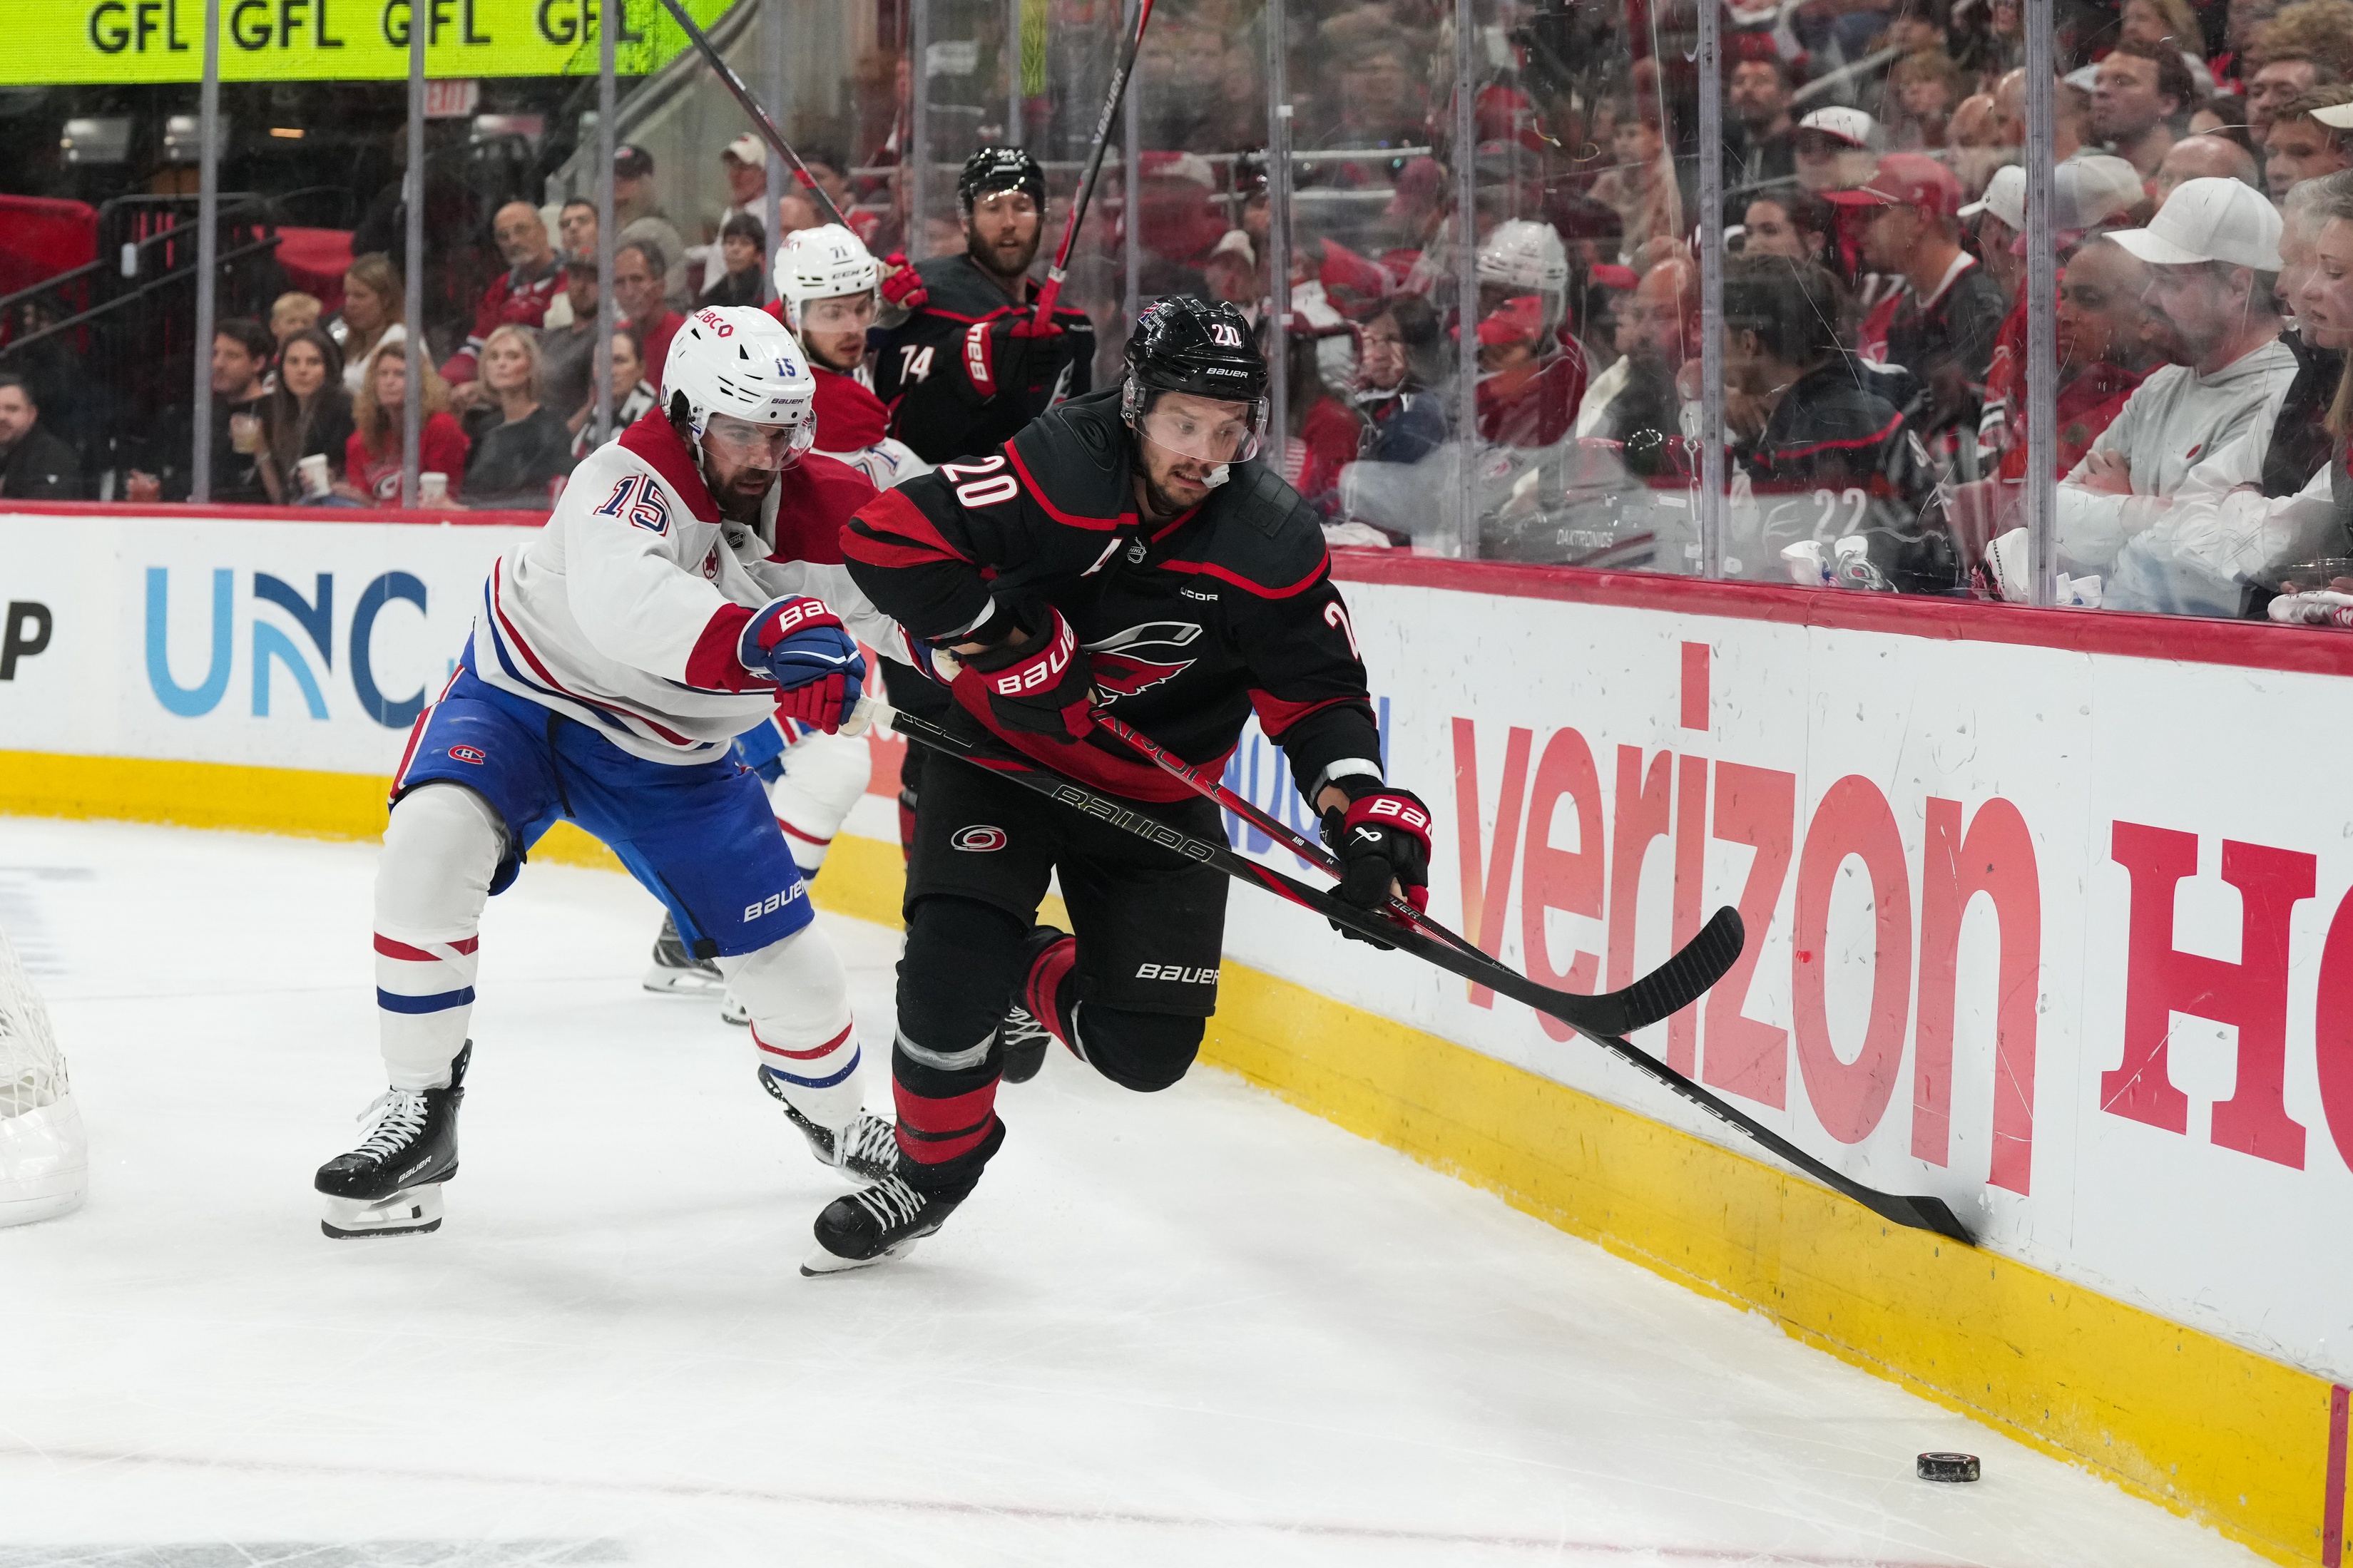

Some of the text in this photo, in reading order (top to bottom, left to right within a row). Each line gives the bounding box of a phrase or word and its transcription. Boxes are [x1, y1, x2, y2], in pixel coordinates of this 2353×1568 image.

[91, 0, 189, 53] GFL
[229, 0, 344, 51] GFL
[383, 0, 491, 47] GFL
[830, 246, 848, 259] 71
[832, 268, 860, 279] CCM
[694, 308, 722, 330] CIBC
[1212, 324, 1241, 347] 20
[775, 358, 796, 377] 15
[899, 344, 936, 386] 74
[1205, 367, 1249, 379] BAUER
[939, 454, 1020, 509] 20
[593, 473, 670, 537] 15
[145, 568, 427, 729] UNC
[1292, 836, 1305, 847] AHO
[1451, 641, 2041, 1197] verizon
[397, 1154, 432, 1184] BAUER
